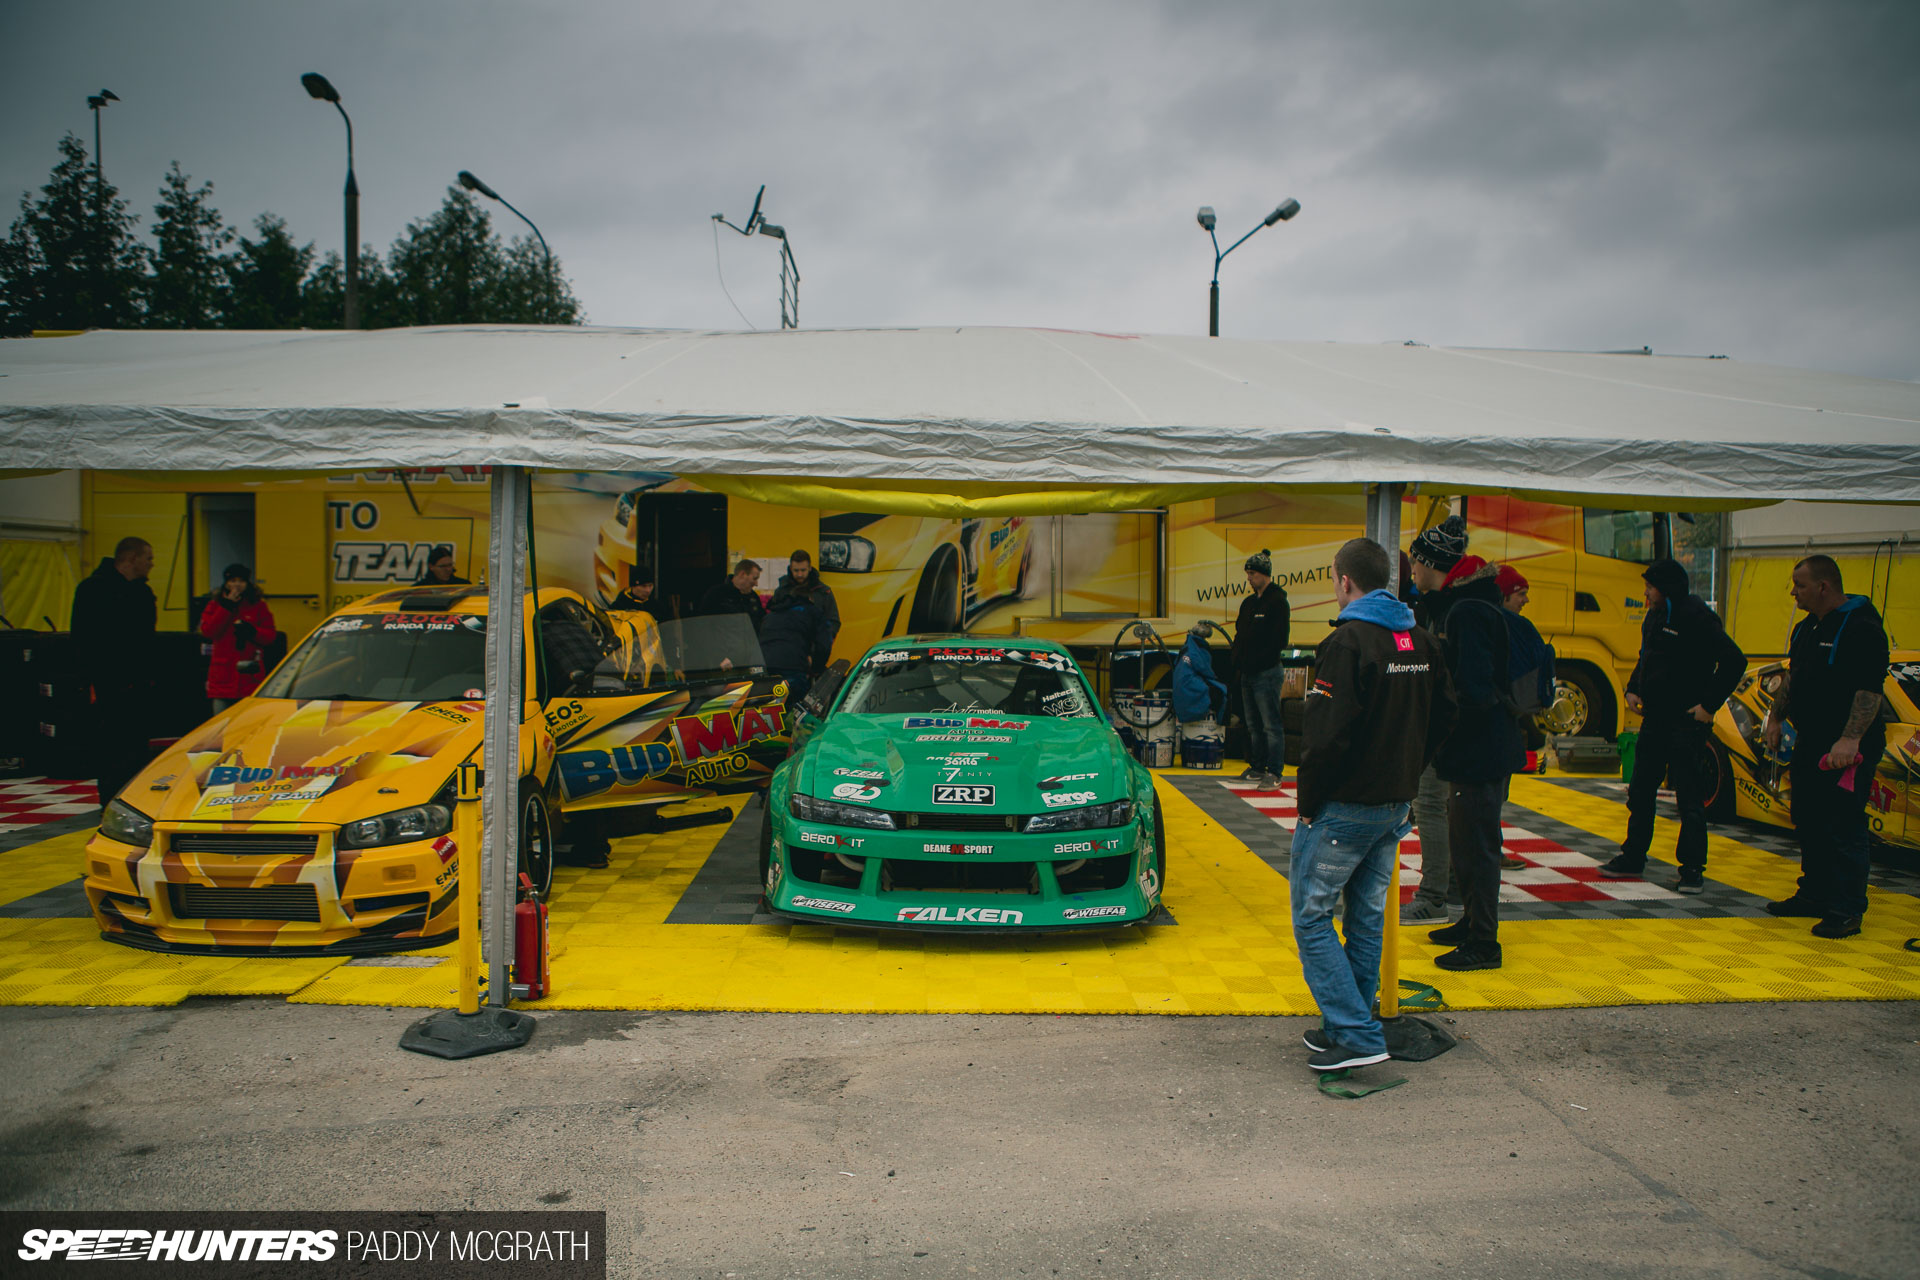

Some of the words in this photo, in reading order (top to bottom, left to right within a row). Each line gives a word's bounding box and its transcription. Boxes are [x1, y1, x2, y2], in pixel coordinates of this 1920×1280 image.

[327, 502, 378, 529] TO
[928, 648, 1005, 657] PŁOCK
[1386, 662, 1430, 675] Motorsport
[1042, 688, 1077, 703] Haltech
[426, 706, 471, 723] ENEOS
[903, 717, 965, 729] BUD
[966, 717, 1028, 731] MAT
[556, 743, 673, 802] BUD
[671, 705, 786, 767] MAT
[207, 767, 273, 787] BUD
[686, 753, 749, 787] AUTO
[249, 784, 292, 792] AUTO
[937, 787, 991, 802] ZRP
[1739, 778, 1771, 809] ENEOS
[207, 794, 264, 807] DRIFT
[268, 791, 320, 801] TEAM
[1042, 791, 1103, 806] Forge
[806, 898, 856, 913] WISEFAB
[1078, 906, 1127, 917] WISEFAB
[896, 907, 1023, 924] FALKEN
